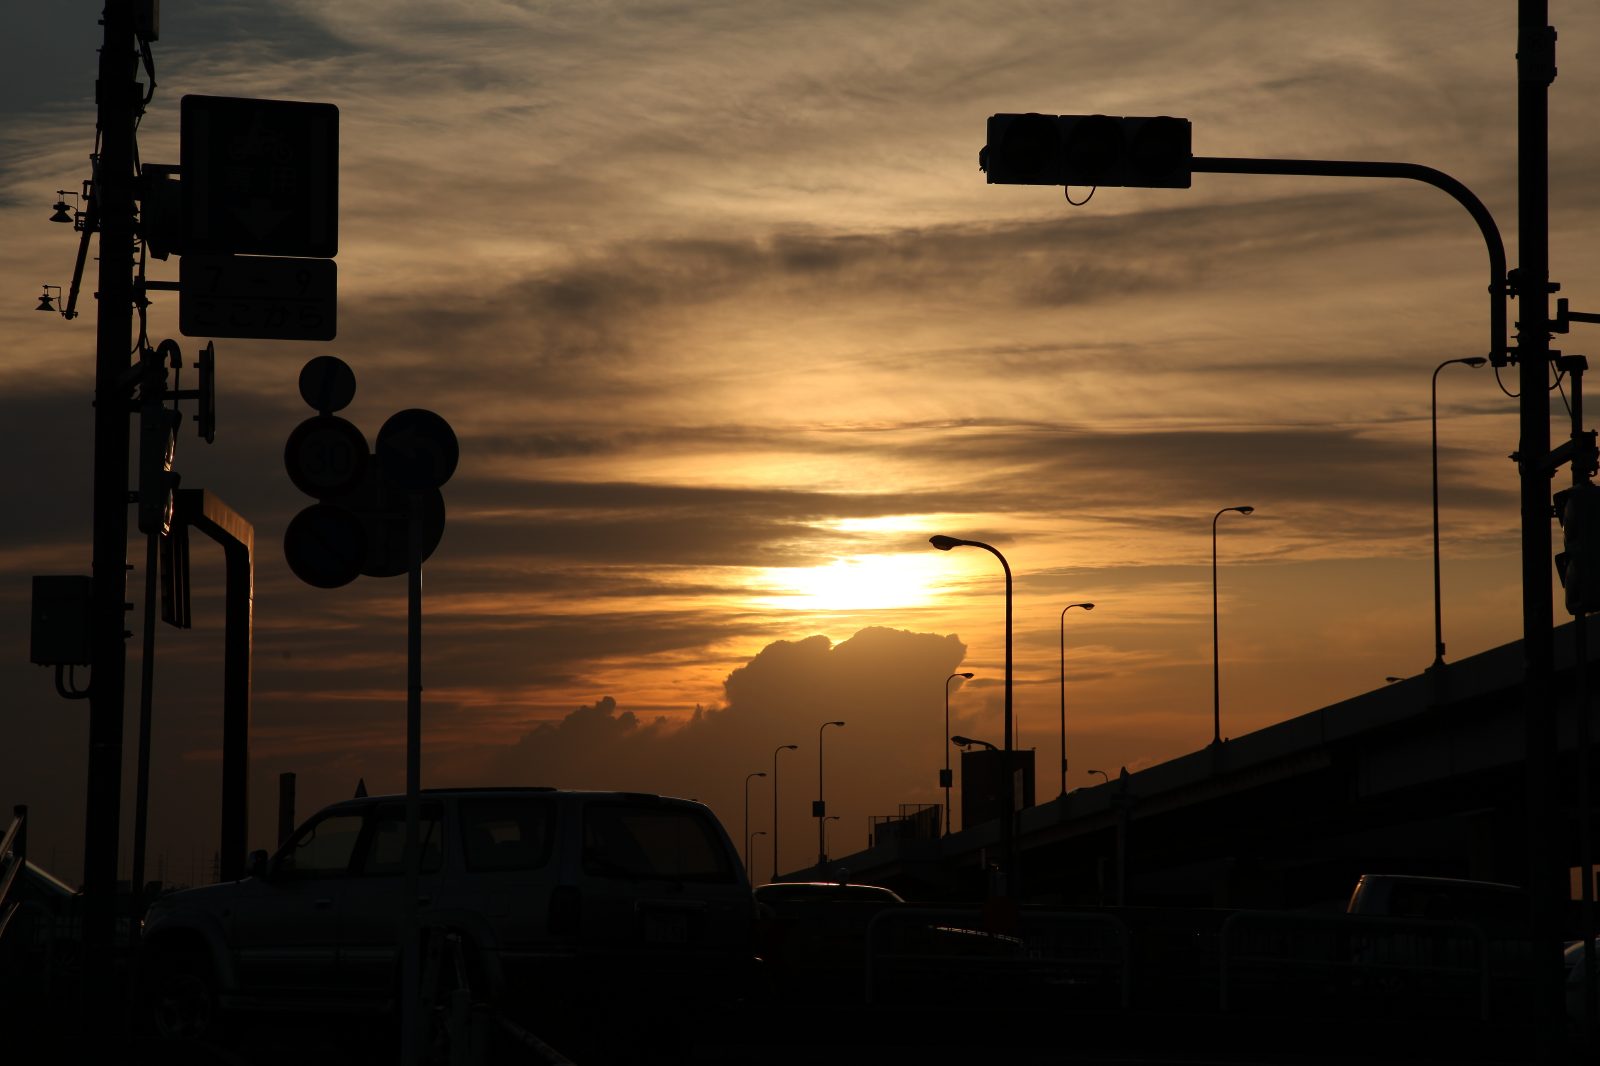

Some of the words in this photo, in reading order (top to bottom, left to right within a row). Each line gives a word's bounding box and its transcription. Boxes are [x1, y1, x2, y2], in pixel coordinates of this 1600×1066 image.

[193, 301, 324, 329] ここから
[305, 440, 351, 475] 30
